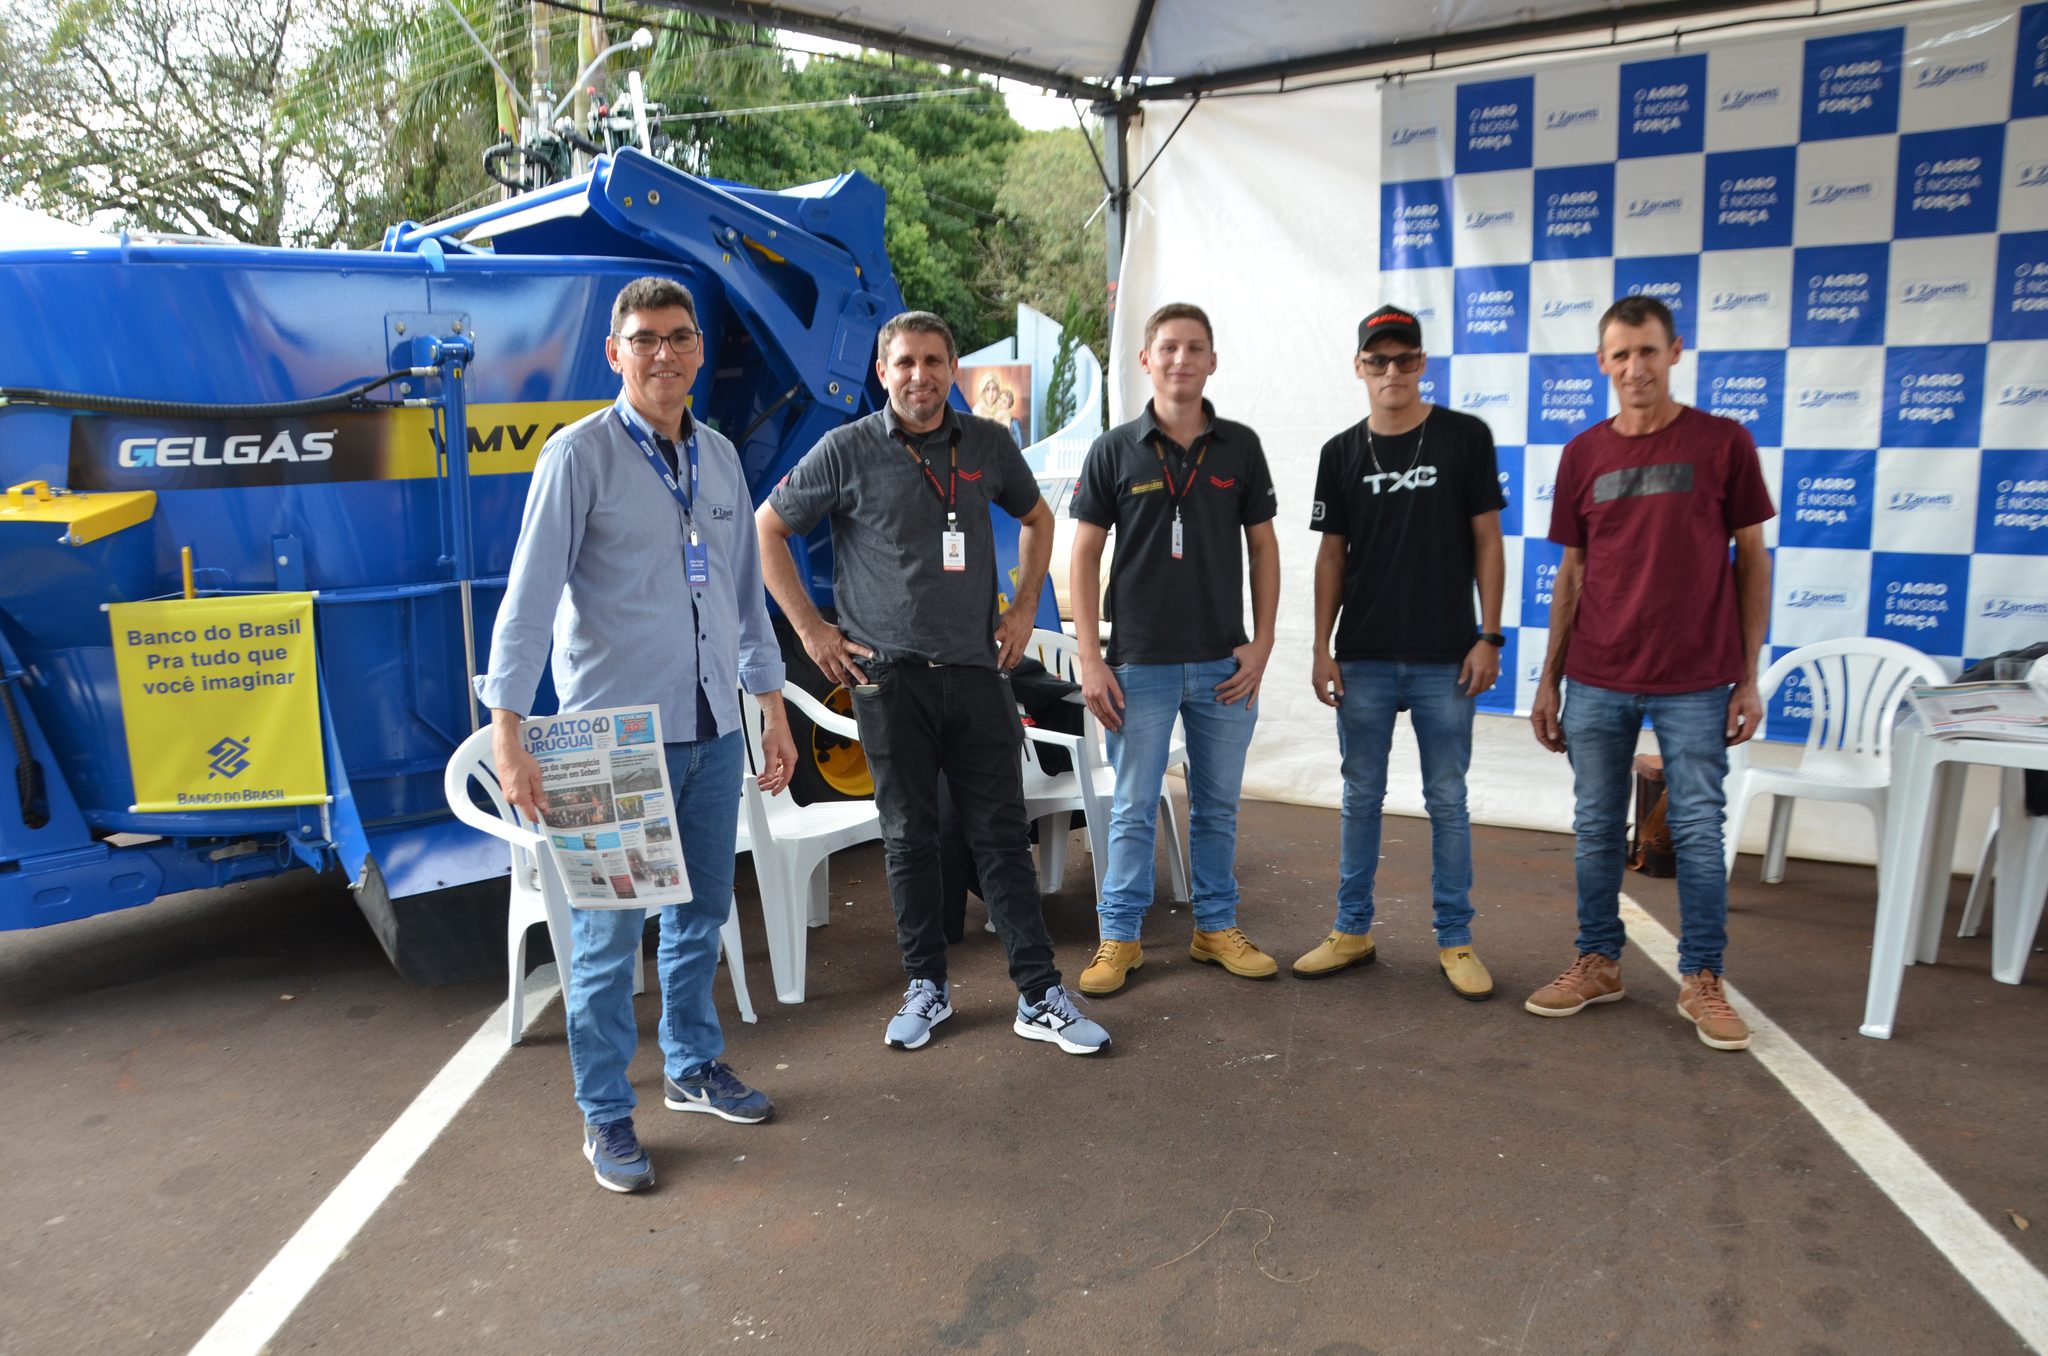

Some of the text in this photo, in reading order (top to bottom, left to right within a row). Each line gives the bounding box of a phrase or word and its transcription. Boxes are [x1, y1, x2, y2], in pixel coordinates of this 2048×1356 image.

[1834, 60, 1882, 79] AGRO
[1647, 84, 1688, 100] AGRO
[1830, 77, 1883, 96] NOSSA
[1481, 104, 1518, 118] AGRO
[1644, 100, 1690, 116] NOSSA
[1818, 95, 1873, 114] FORÇA
[1478, 118, 1519, 135] NOSSA
[1633, 116, 1681, 134] FORÇA
[1469, 134, 1512, 150] FORÇA
[1930, 156, 1982, 174] AGRO
[1733, 176, 1777, 192] AGRO
[1925, 174, 1982, 192] NOSSA
[1560, 191, 1598, 206] AGRO
[1730, 192, 1778, 208] NOSSA
[1912, 193, 1972, 212] FORÇA
[1404, 204, 1438, 218] AGRO
[1556, 206, 1599, 221] NOSSA
[1718, 209, 1769, 226] FORÇA
[1402, 218, 1440, 232] NOSSA
[1546, 222, 1592, 238] FORÇA
[1393, 234, 1434, 249] FORÇA
[1822, 272, 1868, 288] AGRO
[1478, 290, 1514, 304] AGRO
[1640, 282, 1682, 296] AGRO
[1820, 289, 1870, 304] NOSSA
[1476, 304, 1515, 318] NOSSA
[2012, 297, 2048, 312] FOR
[1807, 306, 1860, 323] FORÇA
[1466, 320, 1508, 336] FORÇA
[1418, 381, 1434, 392] RO
[1554, 378, 1592, 391] AGRO
[1725, 376, 1767, 390] AGRO
[1916, 373, 1964, 387] AGRO
[1552, 394, 1594, 406] NOSSA
[1722, 392, 1768, 406] NOSSA
[1912, 390, 1965, 404] NOSSA
[1541, 408, 1586, 423] FORÇA
[1710, 408, 1760, 424] FORÇA
[1899, 408, 1955, 424] FORÇA
[118, 430, 334, 468] GELGÁS
[1363, 465, 1437, 494] TXC
[1812, 477, 1856, 490] AGRO
[2012, 480, 2048, 493] AGR
[1807, 494, 1856, 506] NOSSA
[1796, 509, 1848, 526] FORÇA
[1901, 582, 1948, 596] AGRO
[1896, 598, 1948, 612] NOSSA
[1884, 614, 1938, 631] FORÇA
[127, 618, 301, 646] Banco do Brasil
[147, 648, 288, 670] Pra tudo que
[143, 671, 295, 695] você imaginar
[528, 719, 590, 740] O ALTO
[592, 716, 610, 734] 60
[524, 734, 593, 754] URUGUAI
[177, 788, 285, 805] BANCO DO BRASIL
